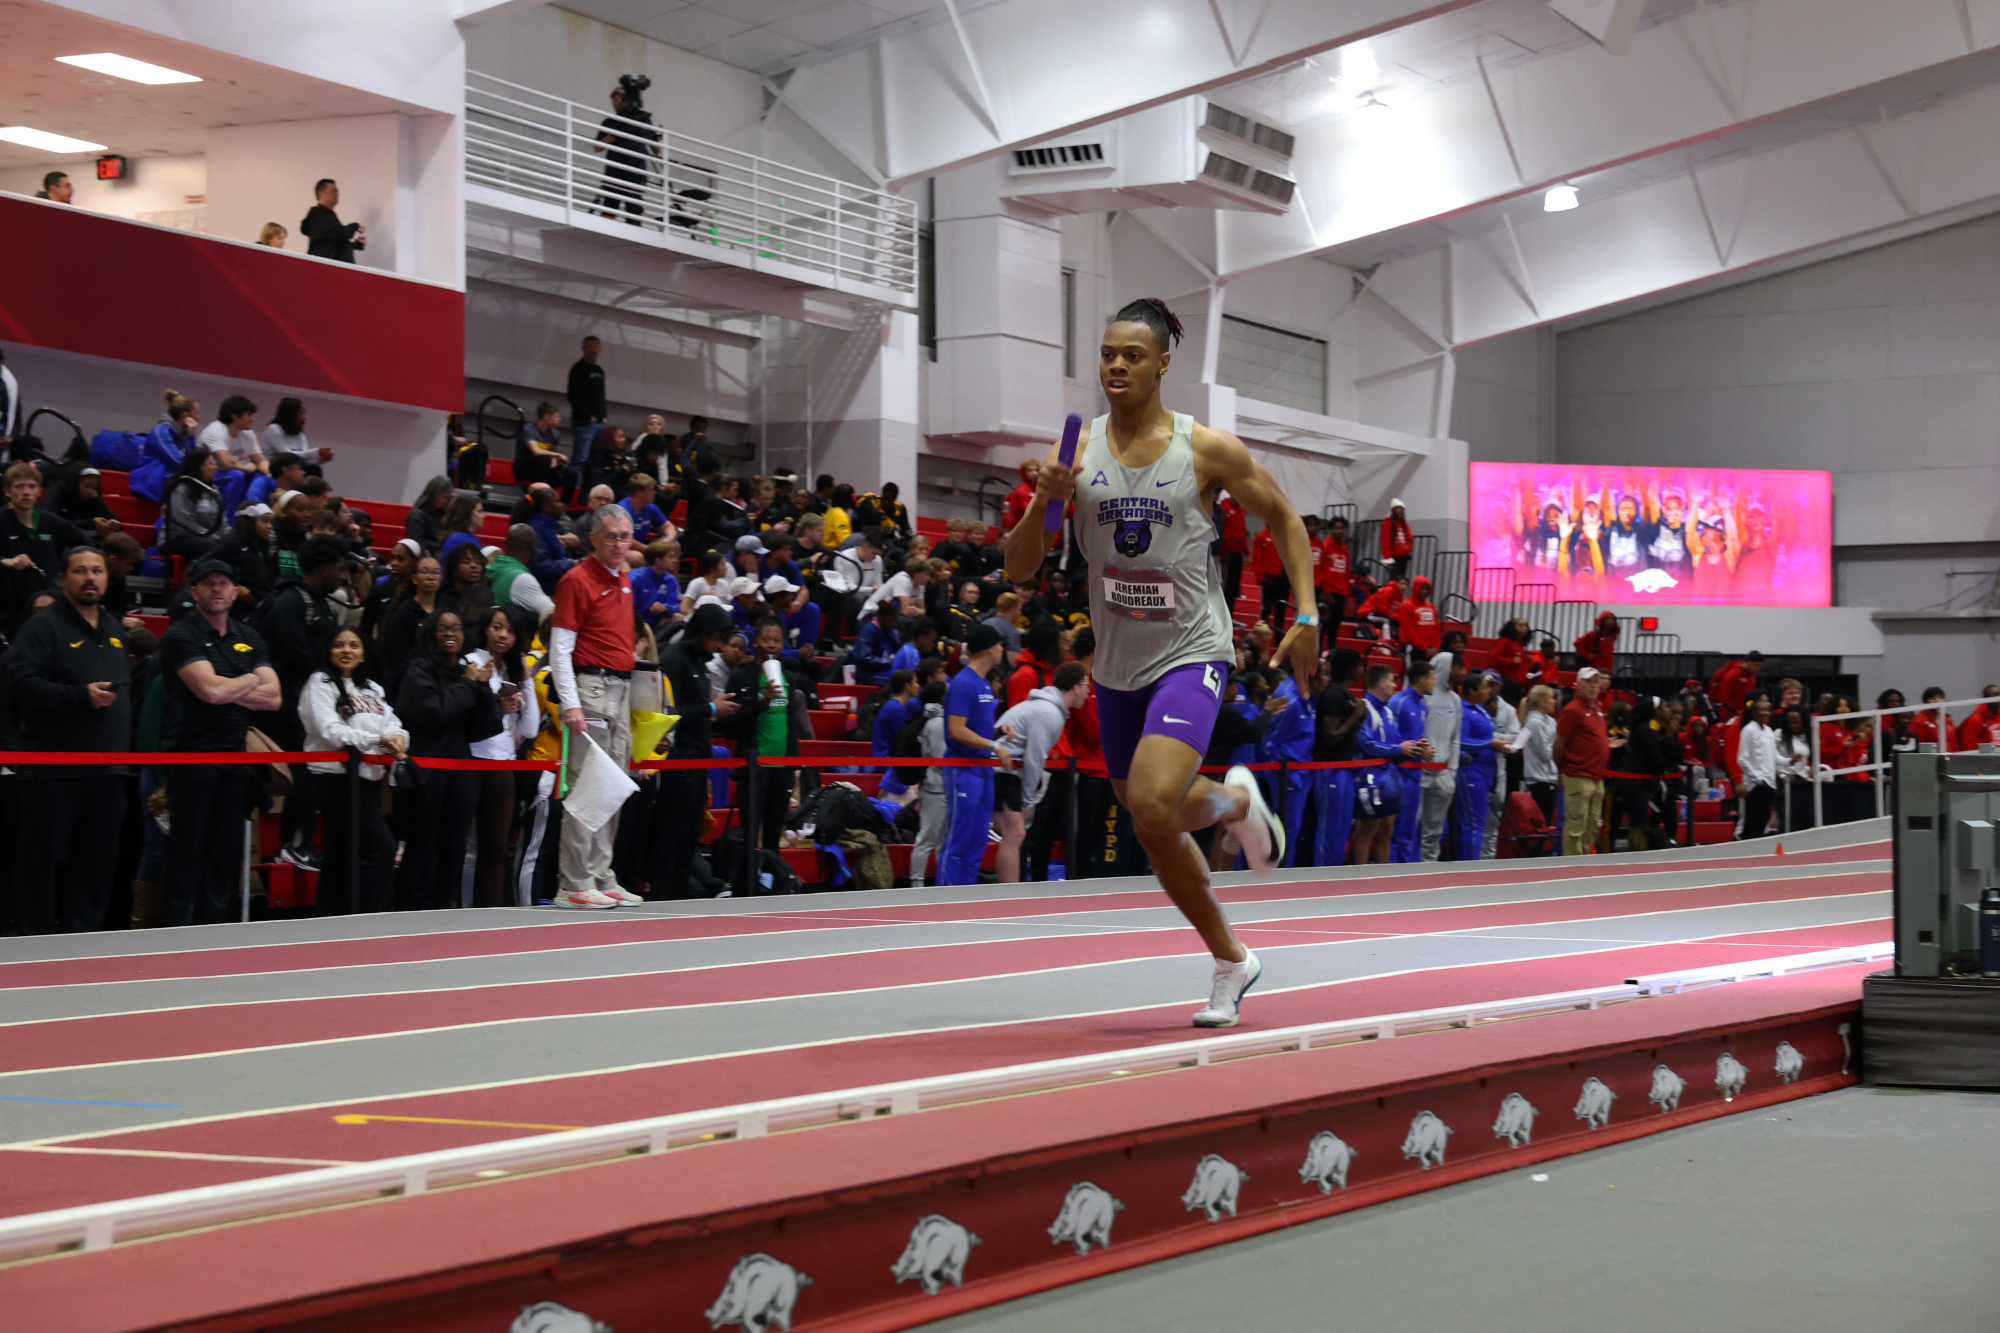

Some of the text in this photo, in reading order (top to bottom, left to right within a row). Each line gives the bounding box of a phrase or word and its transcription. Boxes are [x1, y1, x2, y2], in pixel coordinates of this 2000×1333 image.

[1099, 497, 1170, 513] CENTRAL
[1097, 508, 1174, 525] ARKANSAS
[1114, 581, 1159, 595] JEREMIAH
[1111, 591, 1167, 607] BOUDREAUX
